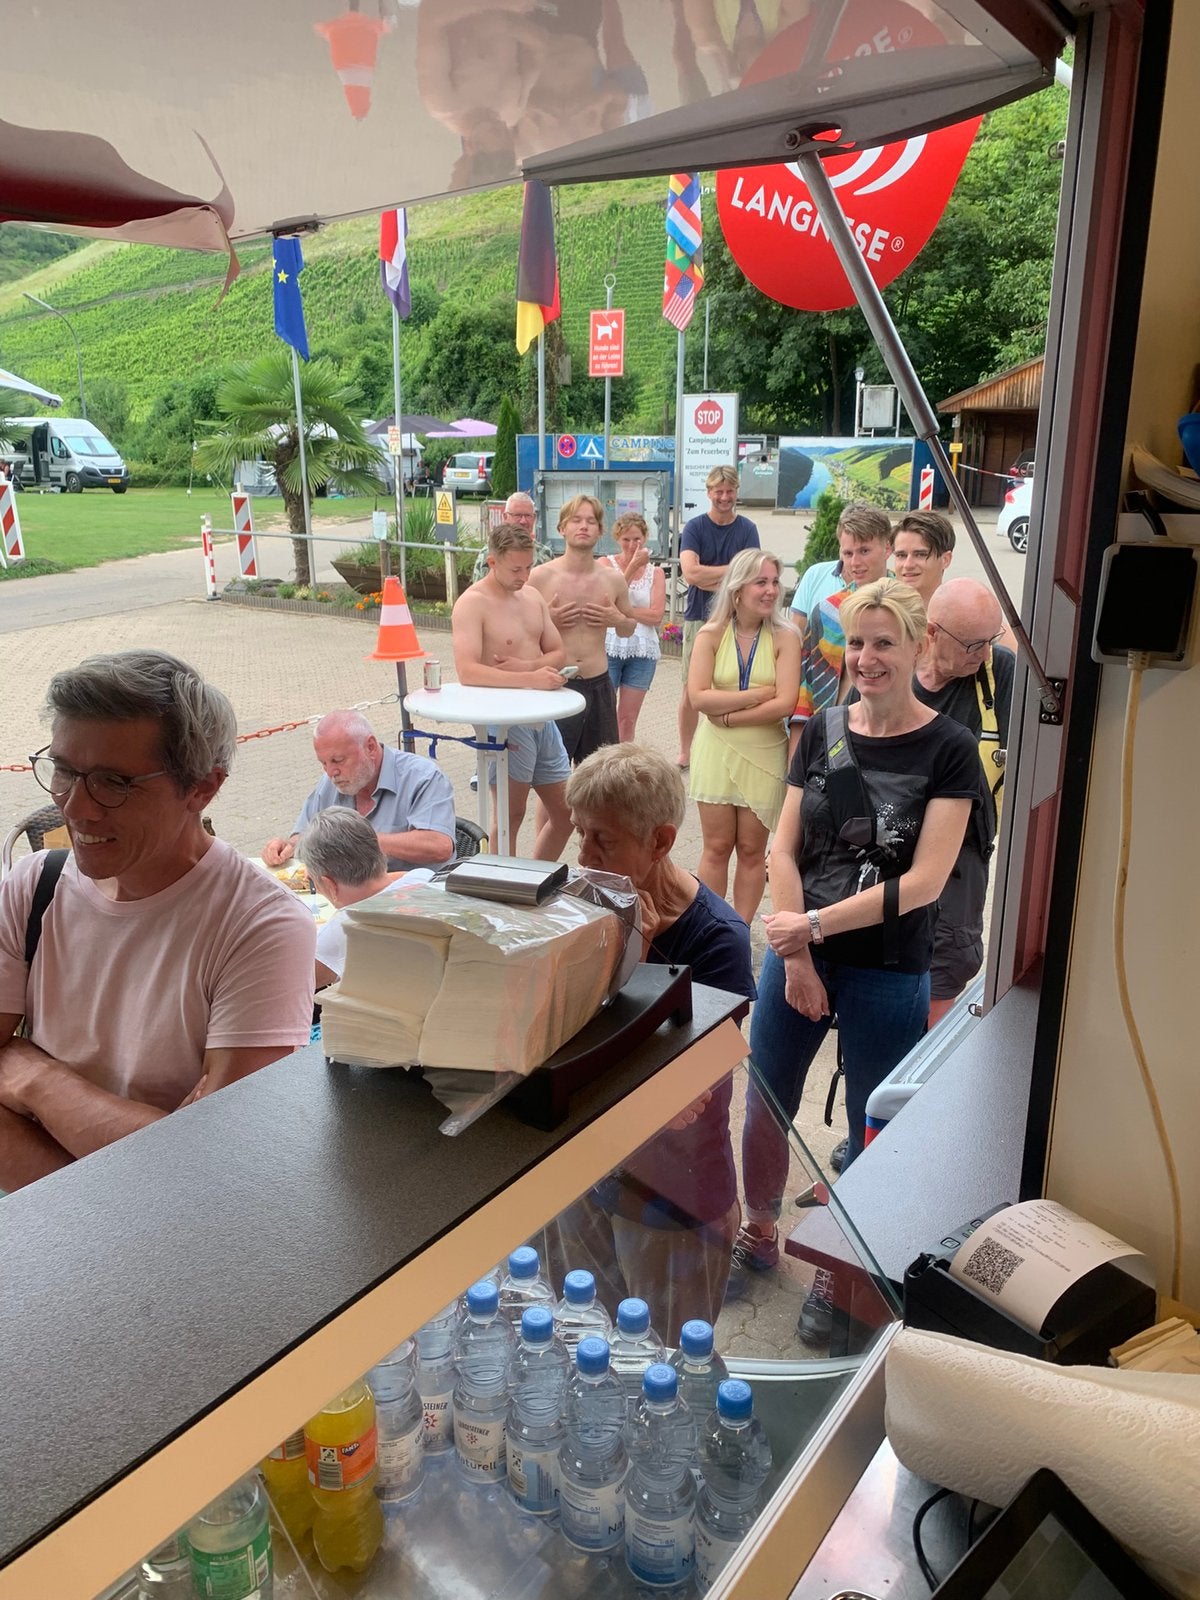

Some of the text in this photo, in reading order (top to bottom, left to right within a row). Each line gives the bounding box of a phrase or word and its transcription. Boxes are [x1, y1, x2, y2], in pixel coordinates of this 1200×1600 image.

[697, 410, 721, 425] STOP
[611, 437, 675, 449] CAMPING
[688, 437, 727, 445] Campingplatz
[423, 1402, 448, 1410] STEINER
